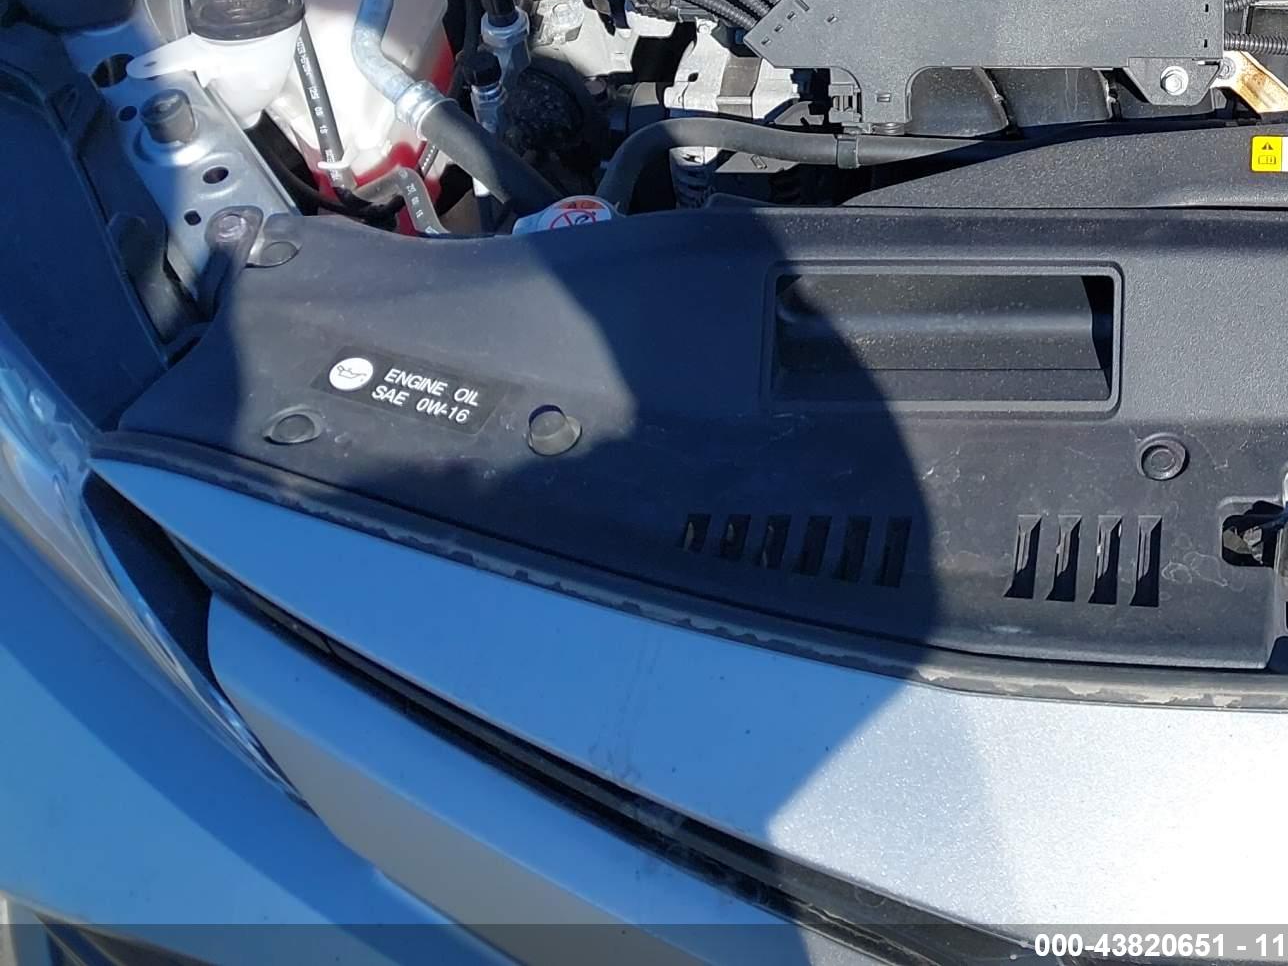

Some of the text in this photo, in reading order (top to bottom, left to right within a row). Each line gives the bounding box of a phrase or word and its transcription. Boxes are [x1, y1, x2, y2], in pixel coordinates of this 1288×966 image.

[371, 385, 471, 424] SAE 0W-16
[384, 369, 480, 407] ENGINE OIL
